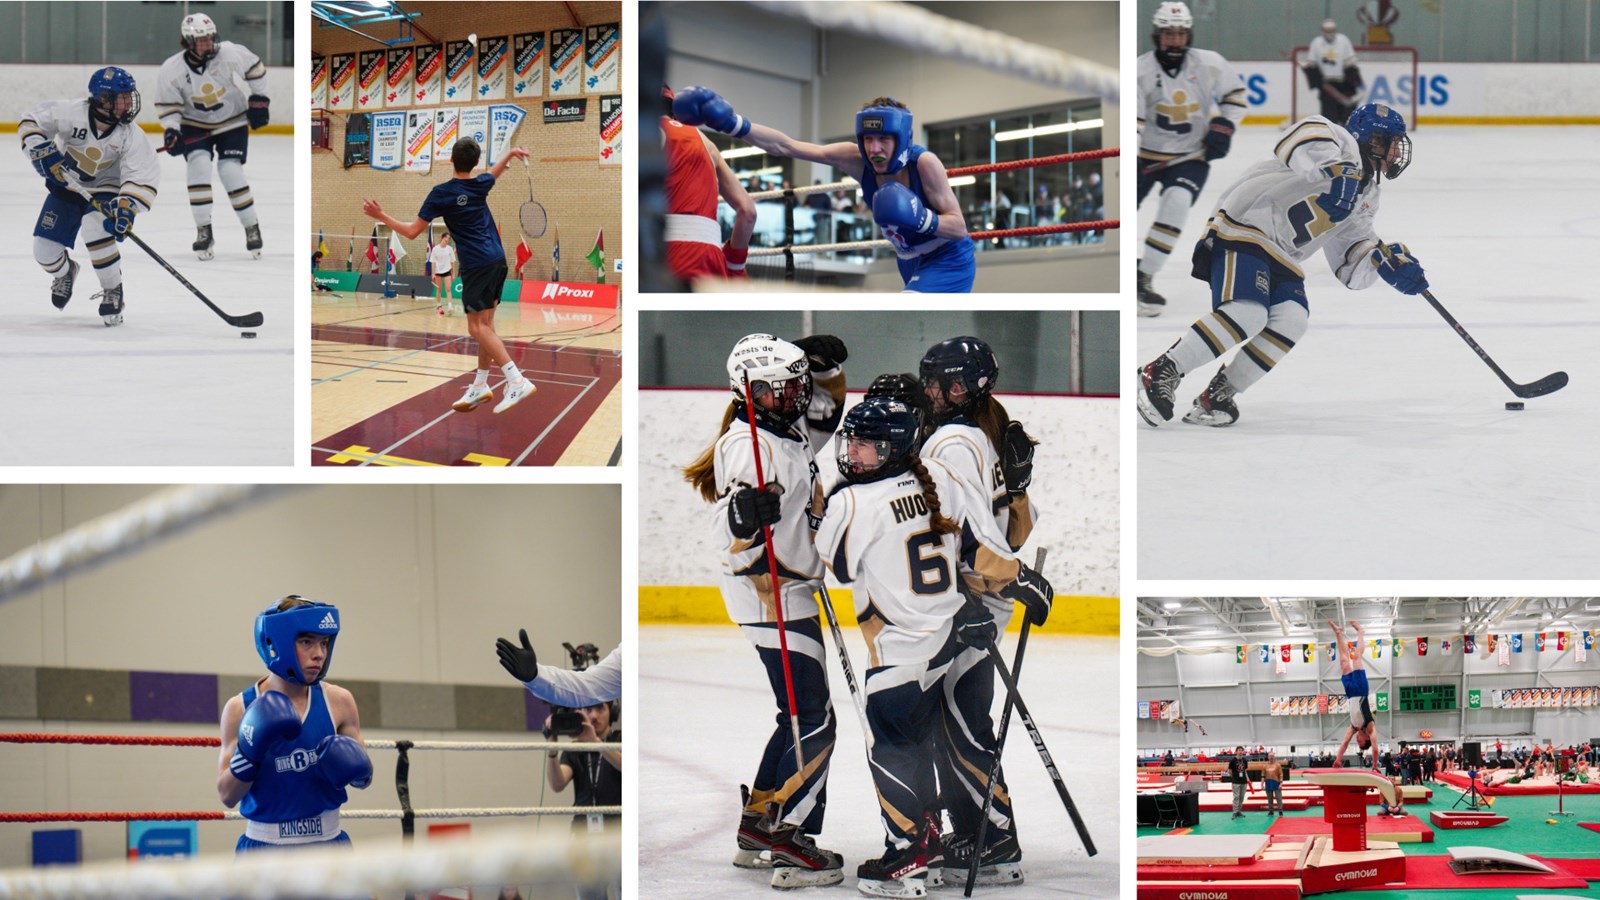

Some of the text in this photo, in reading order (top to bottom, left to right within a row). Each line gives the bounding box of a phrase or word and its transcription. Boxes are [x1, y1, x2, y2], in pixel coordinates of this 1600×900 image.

[1357, 74, 1449, 106] ASIS
[544, 106, 579, 116] De Facto
[602, 106, 622, 127] HANDBA
[376, 118, 401, 127] RSEQ
[72, 128, 87, 140] 18
[408, 118, 432, 144] BASKETBALL
[558, 286, 594, 298] Proxi
[734, 346, 774, 357] westsde
[904, 528, 953, 596] 6
[1023, 713, 1061, 780] TRIBE
[294, 752, 307, 769] R
[281, 818, 321, 836] RINGSIDE
[892, 862, 917, 878] CCM
[1335, 868, 1378, 882] GYMNOVA
[1179, 892, 1228, 900] GYMNOVA
